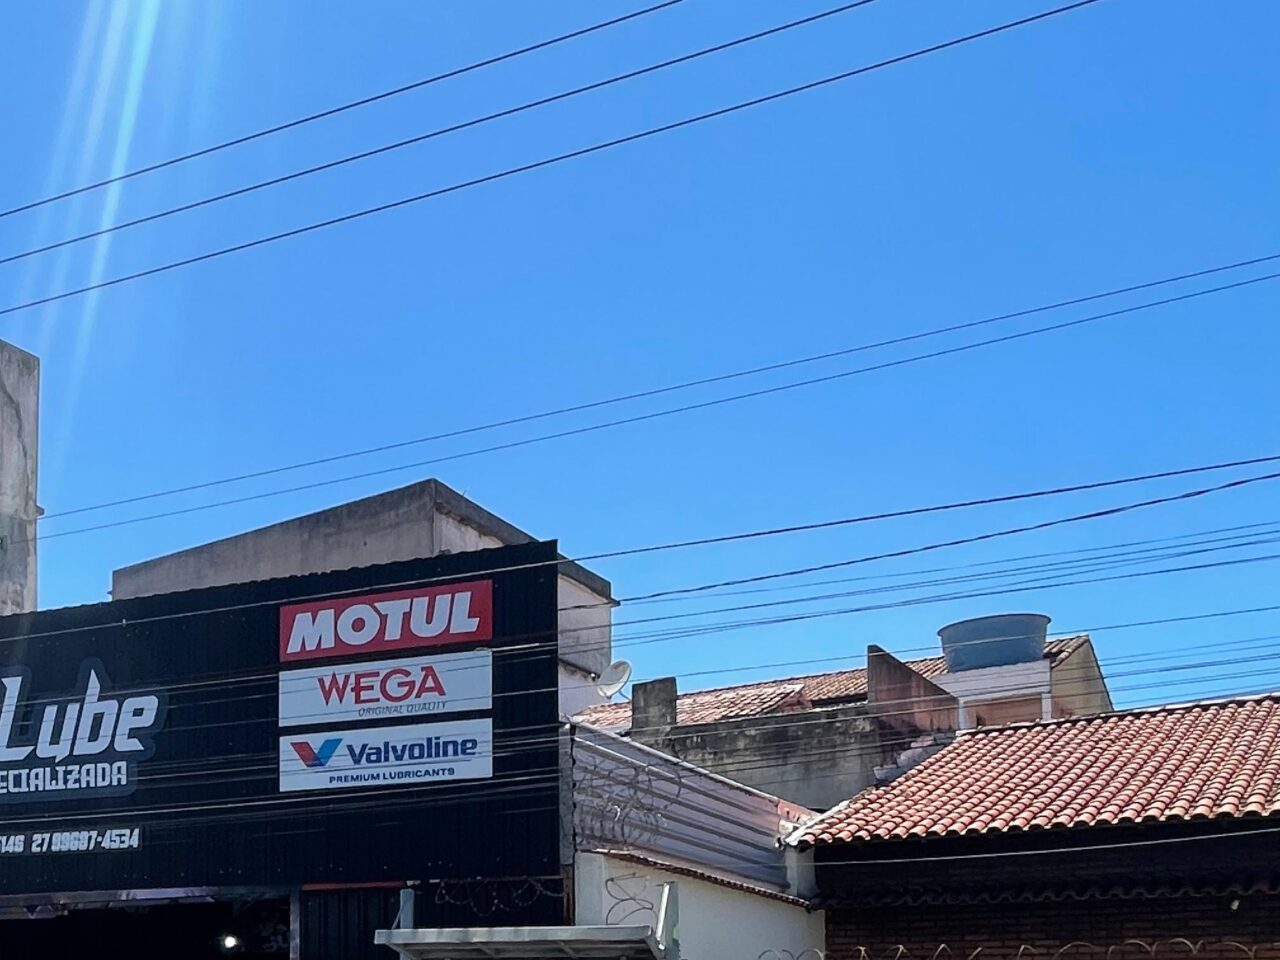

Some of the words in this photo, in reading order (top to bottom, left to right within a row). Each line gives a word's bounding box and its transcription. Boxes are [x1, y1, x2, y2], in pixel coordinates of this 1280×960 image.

[286, 591, 480, 654] MOTUL
[318, 665, 447, 706] WEGA
[358, 704, 403, 718] ORIGINAL
[406, 701, 448, 715] QUALITY
[346, 736, 478, 766] Valvoline
[329, 771, 380, 784] PREMIUM
[382, 766, 455, 781] LUBRICANTS
[31, 832, 50, 853] 27
